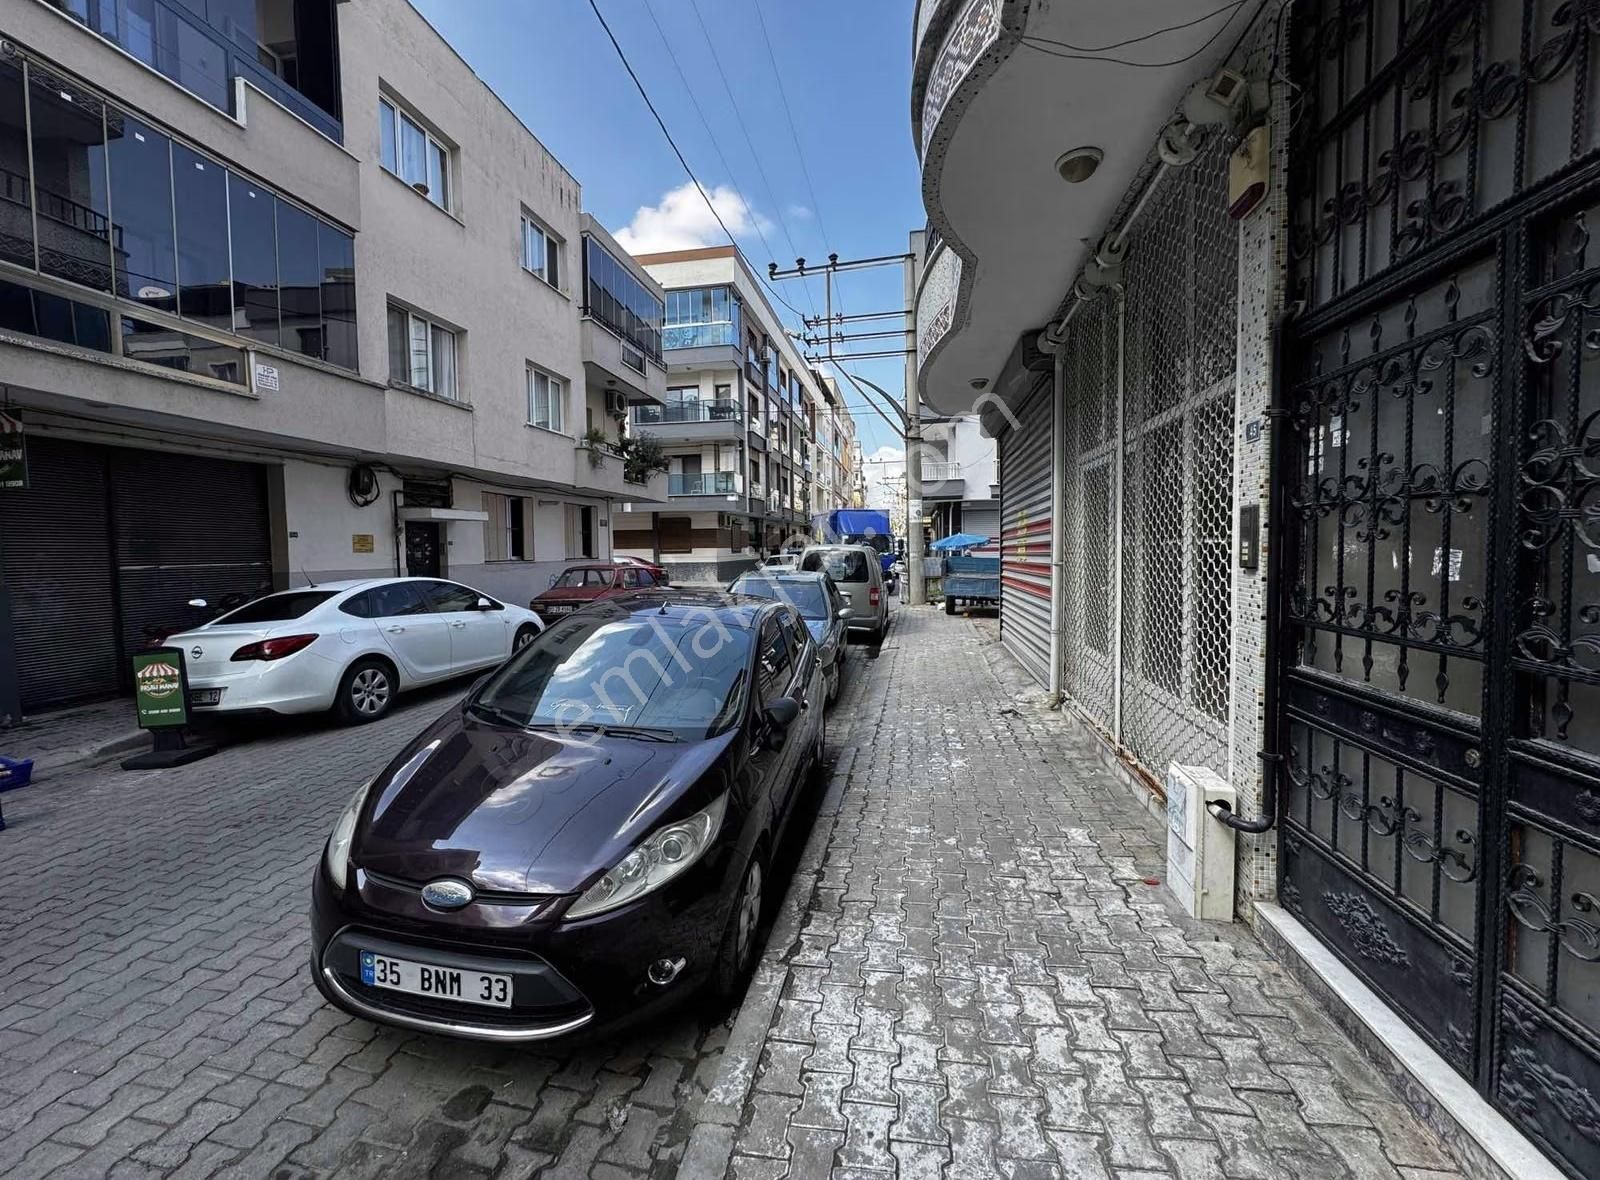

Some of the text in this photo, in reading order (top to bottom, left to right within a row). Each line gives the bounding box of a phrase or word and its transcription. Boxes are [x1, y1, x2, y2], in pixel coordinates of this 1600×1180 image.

[376, 959, 400, 986] 35
[420, 967, 461, 996] BNM
[479, 976, 508, 1002] 33
